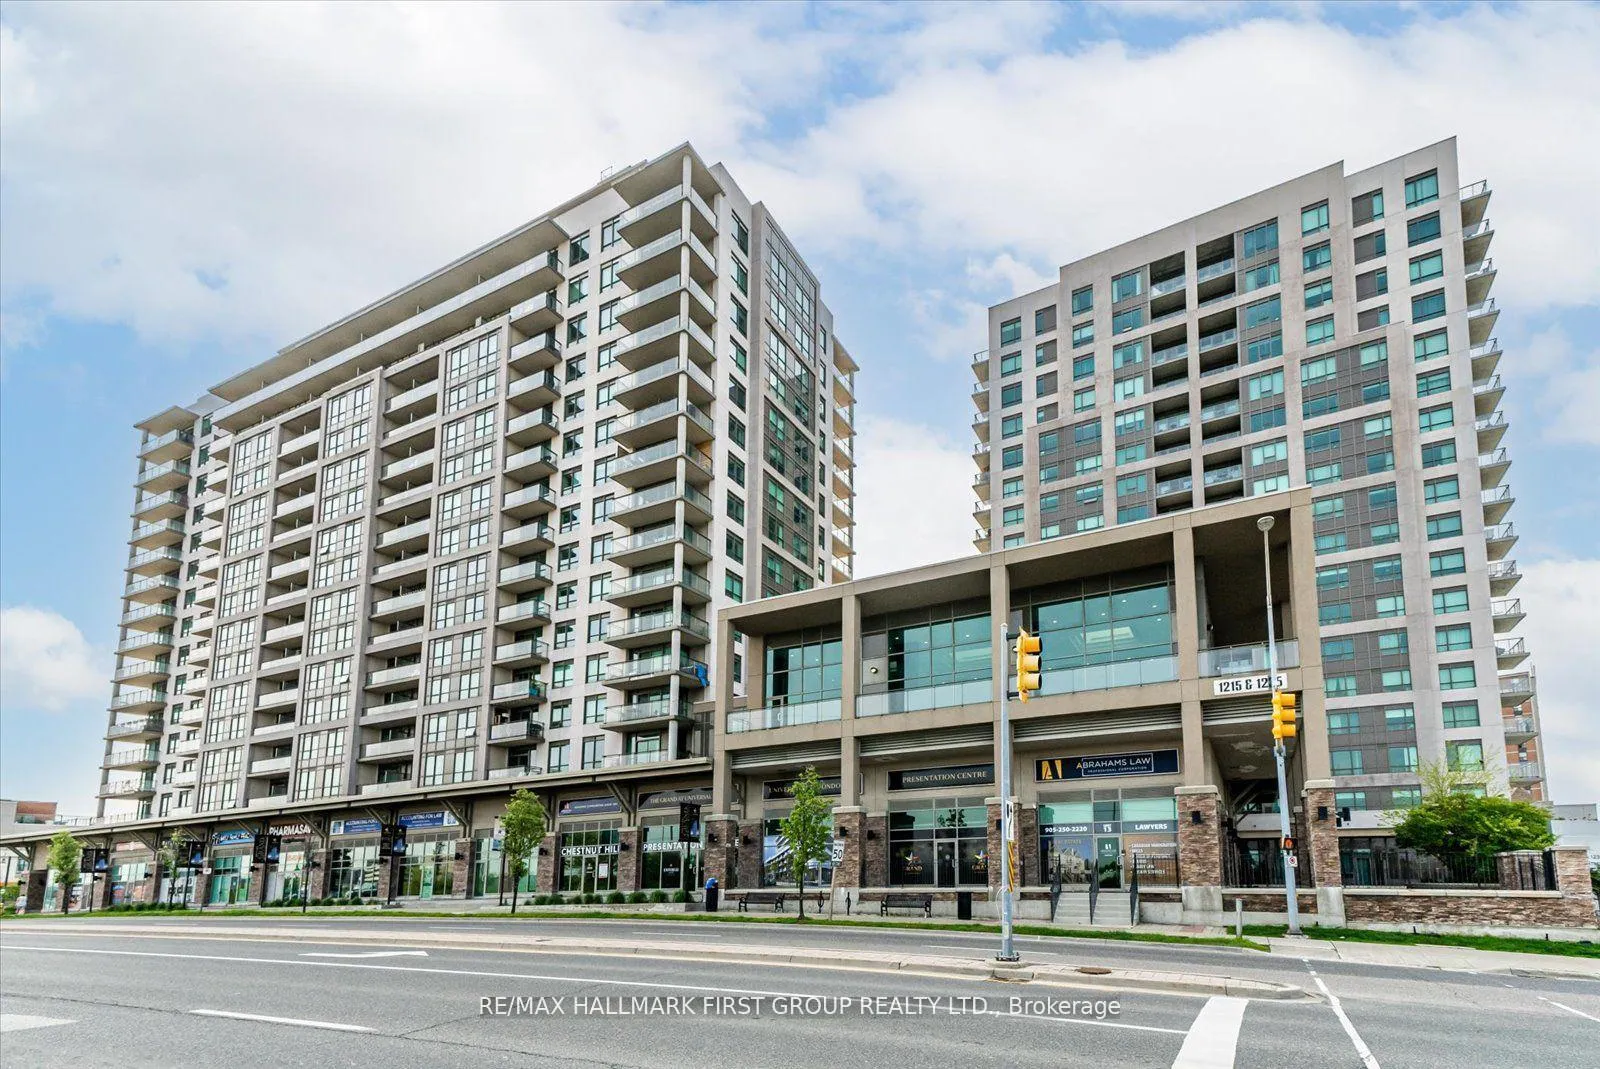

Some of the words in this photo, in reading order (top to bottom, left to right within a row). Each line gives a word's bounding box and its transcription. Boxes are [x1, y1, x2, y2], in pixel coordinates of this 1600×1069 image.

[1218, 680, 1242, 693] 1215
[1245, 678, 1253, 691] &
[1256, 675, 1283, 689] 125
[1076, 758, 1127, 769] ABRAHAMS
[1129, 756, 1151, 766] LAW
[902, 773, 956, 783] PRESENTATION
[956, 770, 987, 780] CENTRE
[821, 782, 841, 790] ONDO
[659, 795, 678, 803] GRAND
[684, 793, 712, 802] UNIVERSAL
[269, 824, 311, 836] PHARMASAV
[1134, 823, 1168, 831] LAWYERS
[561, 846, 603, 856] CHESTNUT
[643, 841, 703, 851] PRESENTATON
[833, 849, 843, 860] 50
